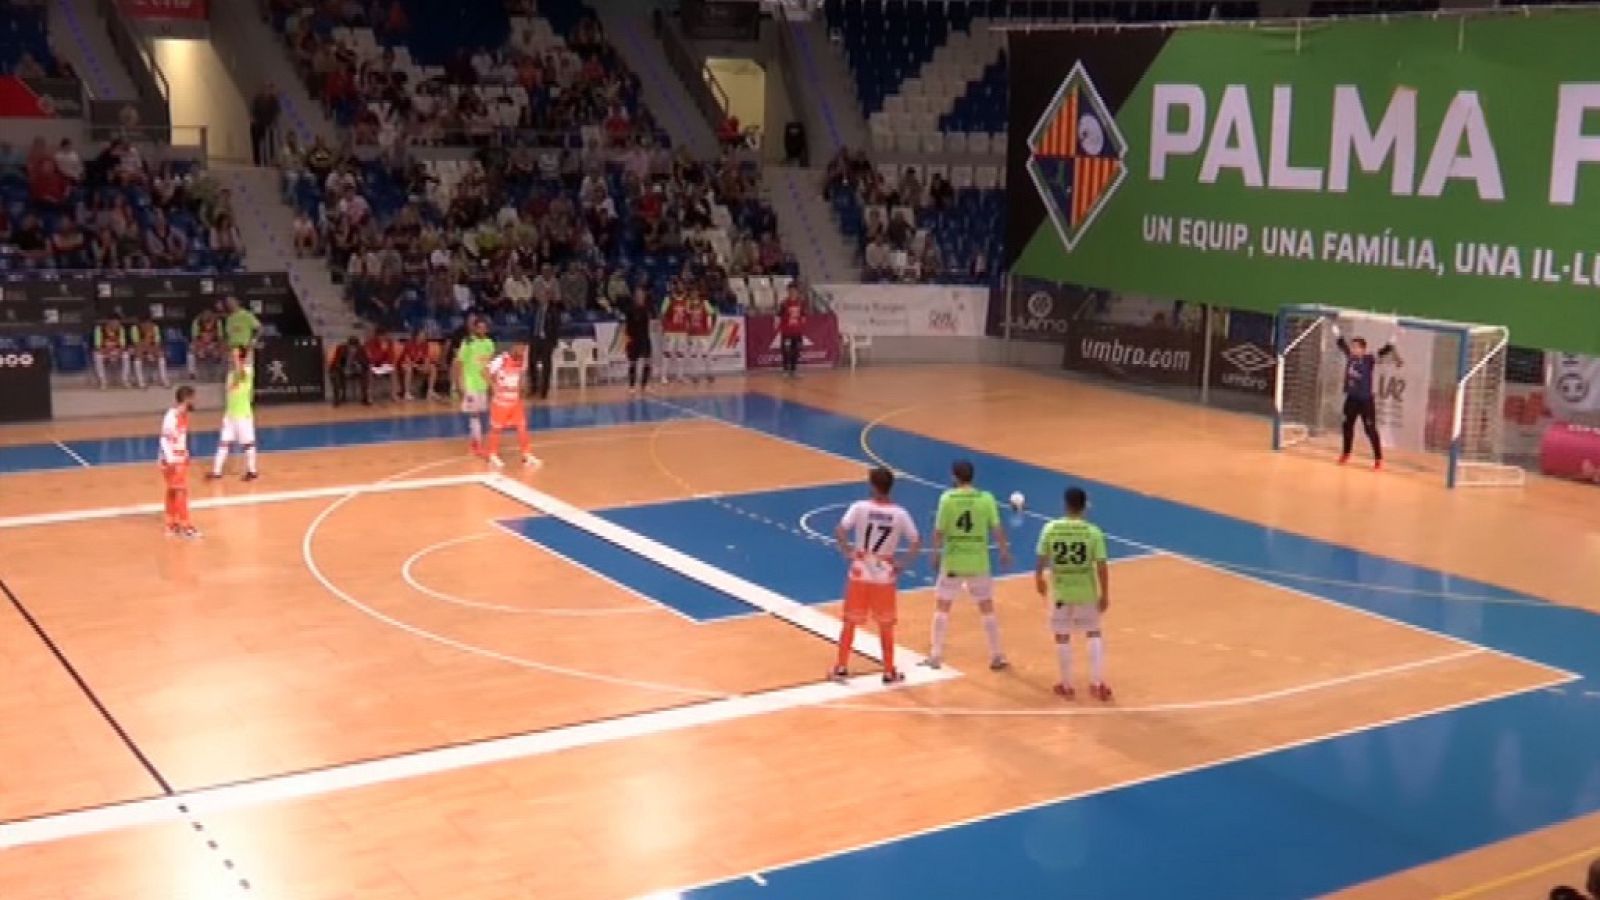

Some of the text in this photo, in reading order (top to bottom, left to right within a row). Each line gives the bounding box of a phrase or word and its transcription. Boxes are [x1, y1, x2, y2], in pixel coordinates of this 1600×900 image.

[1149, 84, 1505, 200] PALMA
[1143, 214, 1172, 243] UN
[1179, 217, 1254, 257] EQUIP,
[1262, 227, 1314, 260] UNA
[1322, 227, 1444, 277] FAMÍLIA,
[1455, 243, 1521, 278] UNA
[1081, 337, 1191, 371] umbro.com
[864, 522, 892, 553] 17
[956, 510, 973, 534] 4
[1052, 541, 1087, 565] 23
